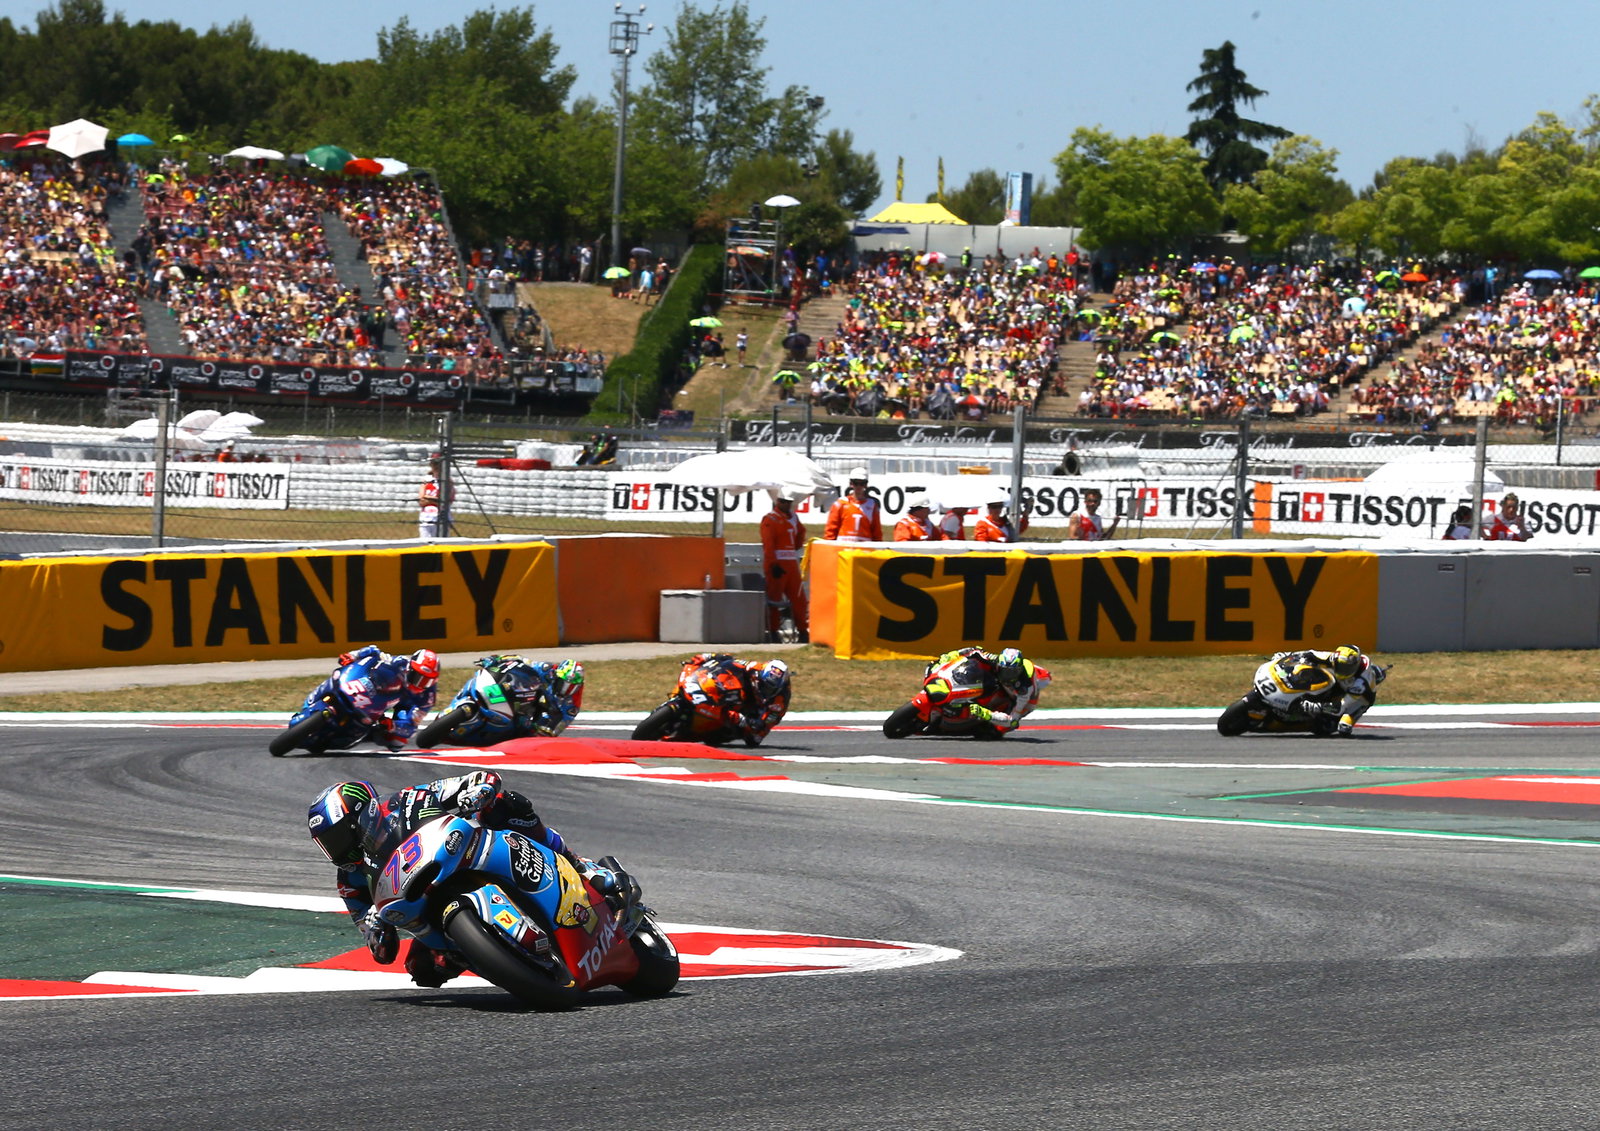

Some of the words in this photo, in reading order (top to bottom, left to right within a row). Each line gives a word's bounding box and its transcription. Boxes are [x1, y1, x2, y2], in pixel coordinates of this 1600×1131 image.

[31, 467, 69, 492] TISSOT
[90, 471, 132, 496] TISSOT
[227, 473, 285, 499] TISSOT
[1329, 493, 1446, 527] TISSOT
[1520, 501, 1600, 536] ISSOT
[101, 549, 511, 651] STANLEY
[876, 556, 1327, 642] STANLEY
[340, 679, 373, 709] 54
[1257, 677, 1278, 696] 12
[385, 832, 424, 895] 73
[514, 836, 532, 877] Estrella
[577, 914, 619, 980] TOTAL
